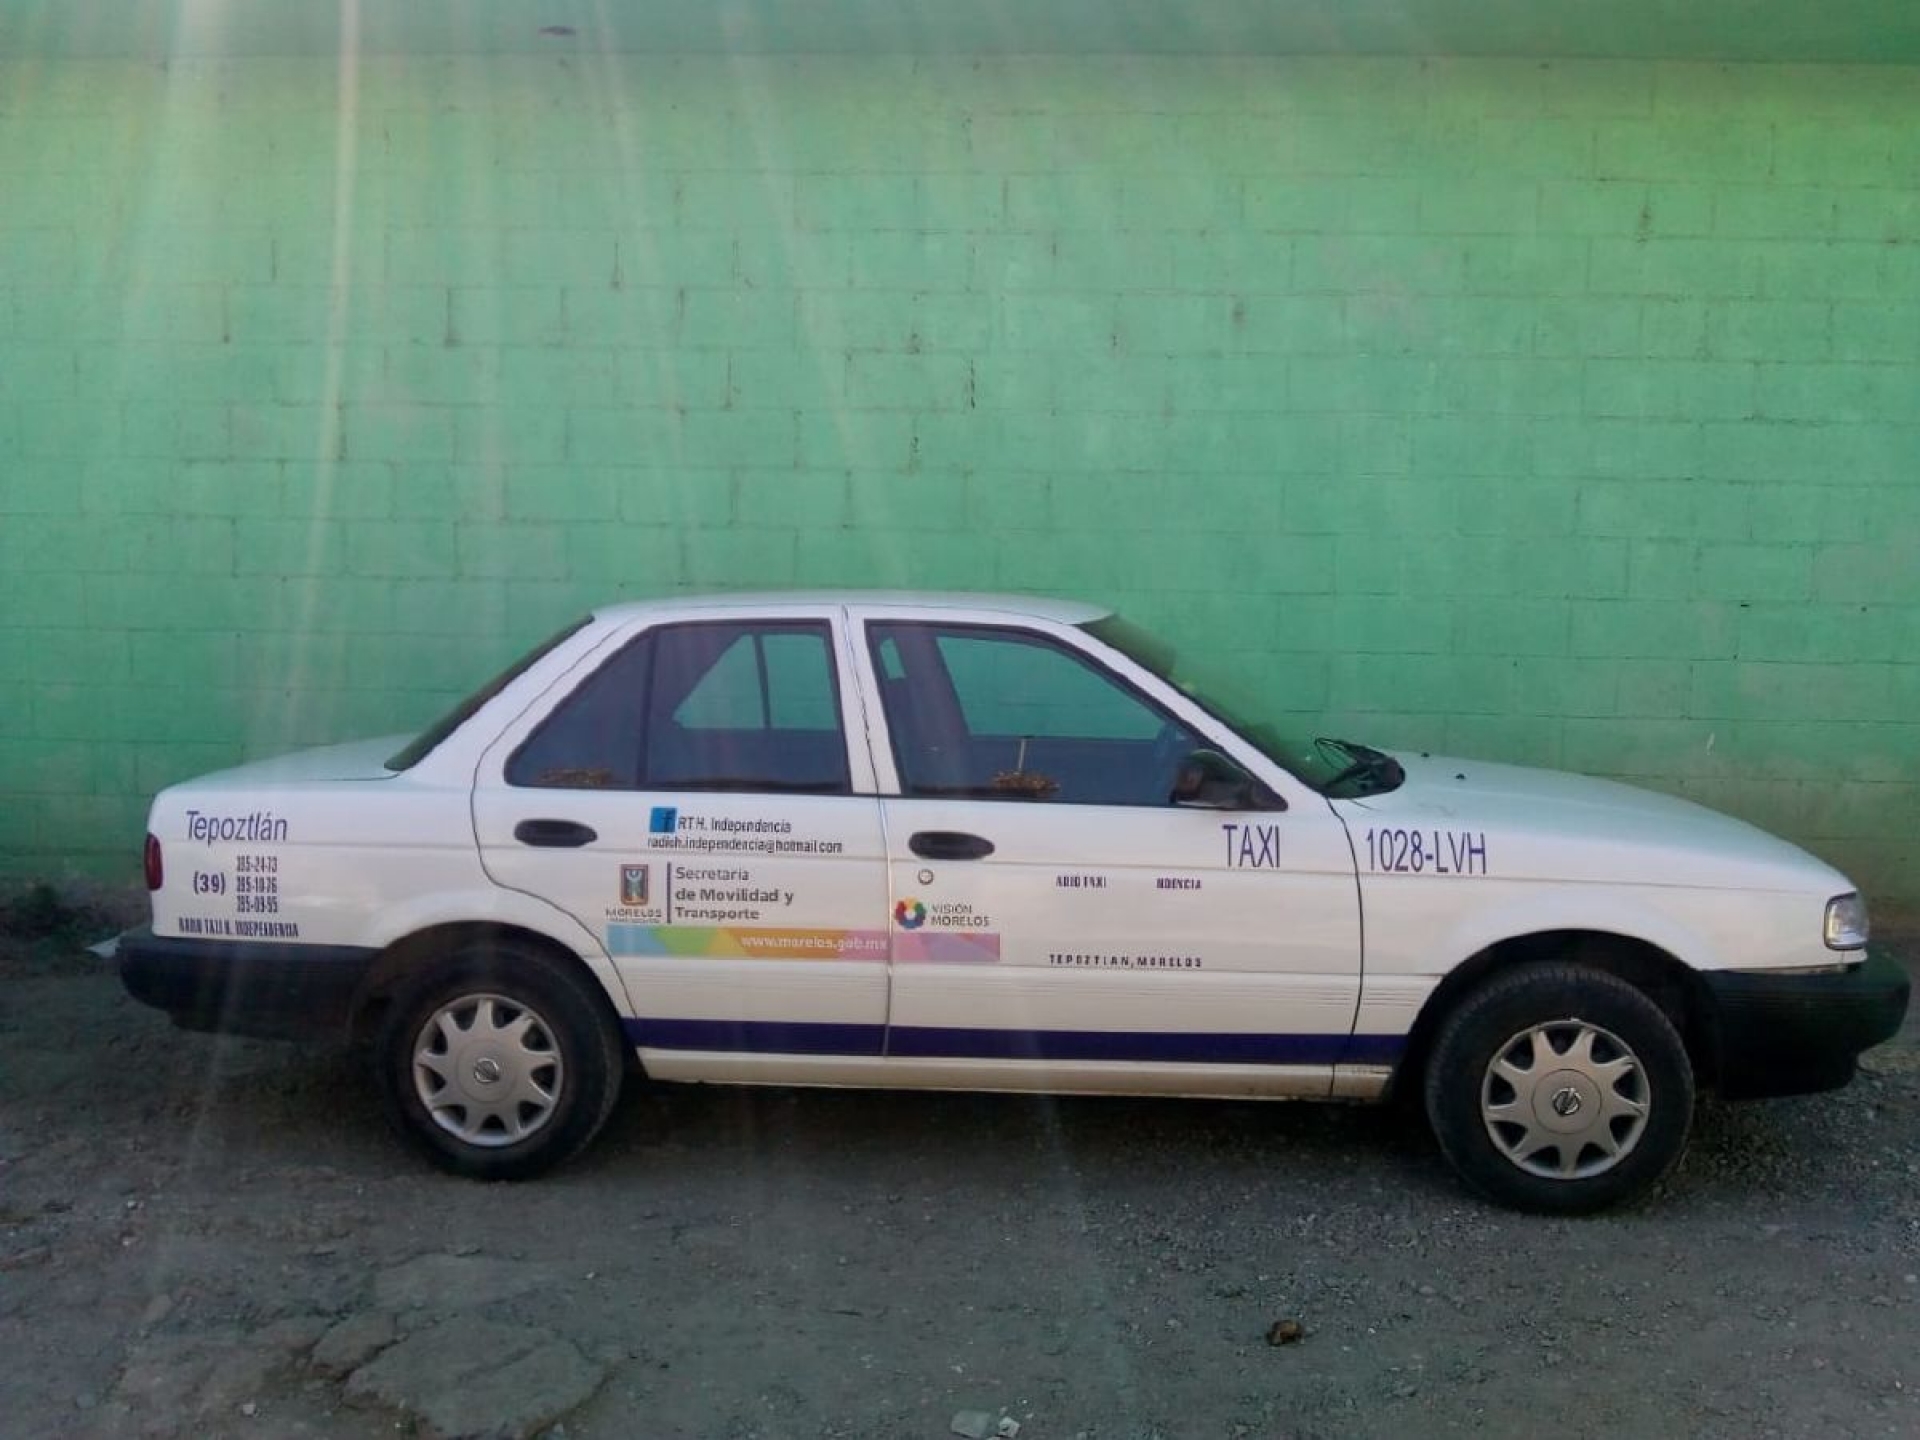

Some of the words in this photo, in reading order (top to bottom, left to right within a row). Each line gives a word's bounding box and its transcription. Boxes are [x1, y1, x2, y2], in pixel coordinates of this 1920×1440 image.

[186, 810, 288, 846] Tepoztlán
[711, 817, 792, 835] Independencia
[1222, 824, 1281, 868] TAXI
[1366, 828, 1487, 875] 1028-LVH
[193, 871, 226, 895] (39)
[675, 887, 696, 902] de
[700, 888, 779, 903] Movilidad
[784, 892, 794, 906] y
[675, 906, 760, 921] Transporte
[931, 915, 990, 927] MORELOS
